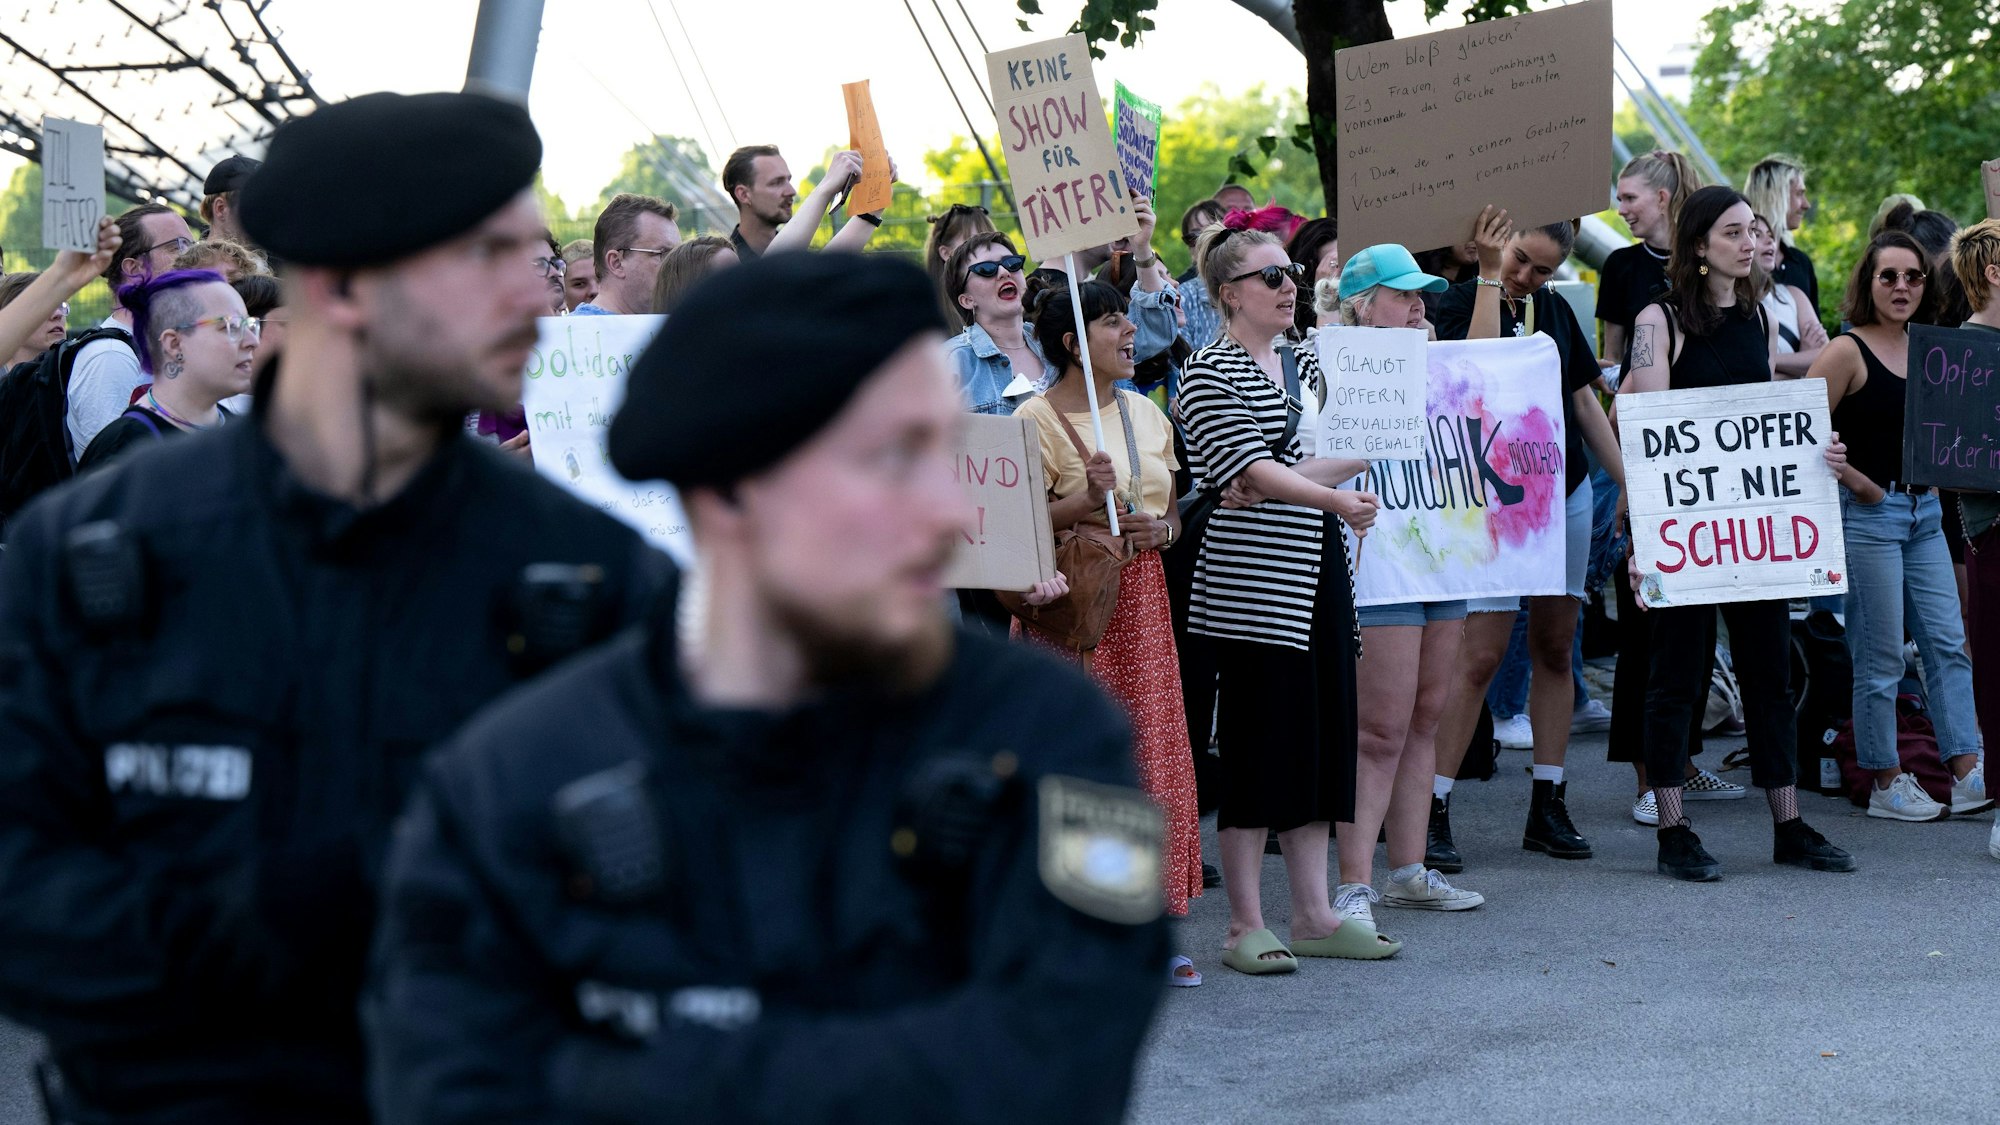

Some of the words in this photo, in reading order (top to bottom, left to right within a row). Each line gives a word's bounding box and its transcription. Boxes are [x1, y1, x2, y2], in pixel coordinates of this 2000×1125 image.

[1007, 53, 1072, 91] KEINE
[1346, 52, 1389, 81] Wem
[1406, 40, 1440, 67] bloß
[1458, 22, 1521, 60] glauben?
[1453, 72, 1471, 86] die
[1490, 53, 1557, 75] unabhängig
[1008, 91, 1088, 152] SHOW
[1468, 137, 1512, 156] seinen
[1525, 116, 1586, 139] Gedichten
[1042, 145, 1080, 173] FÜR
[1352, 178, 1455, 211] Vergewaltigung
[1476, 141, 1570, 181] romantisiert?
[1022, 169, 1126, 238] TÄTER!
[1336, 347, 1406, 375] GLAUBT
[1924, 346, 1994, 396] Opfer
[535, 402, 572, 431] mit
[1335, 387, 1405, 405] OPFERN
[1327, 436, 1355, 451] TER
[1642, 420, 1700, 458] DAS
[1715, 411, 1817, 452] OPFER
[1663, 466, 1719, 507] IST
[1741, 464, 1801, 500] NIE
[1655, 515, 1819, 574] SCHULD
